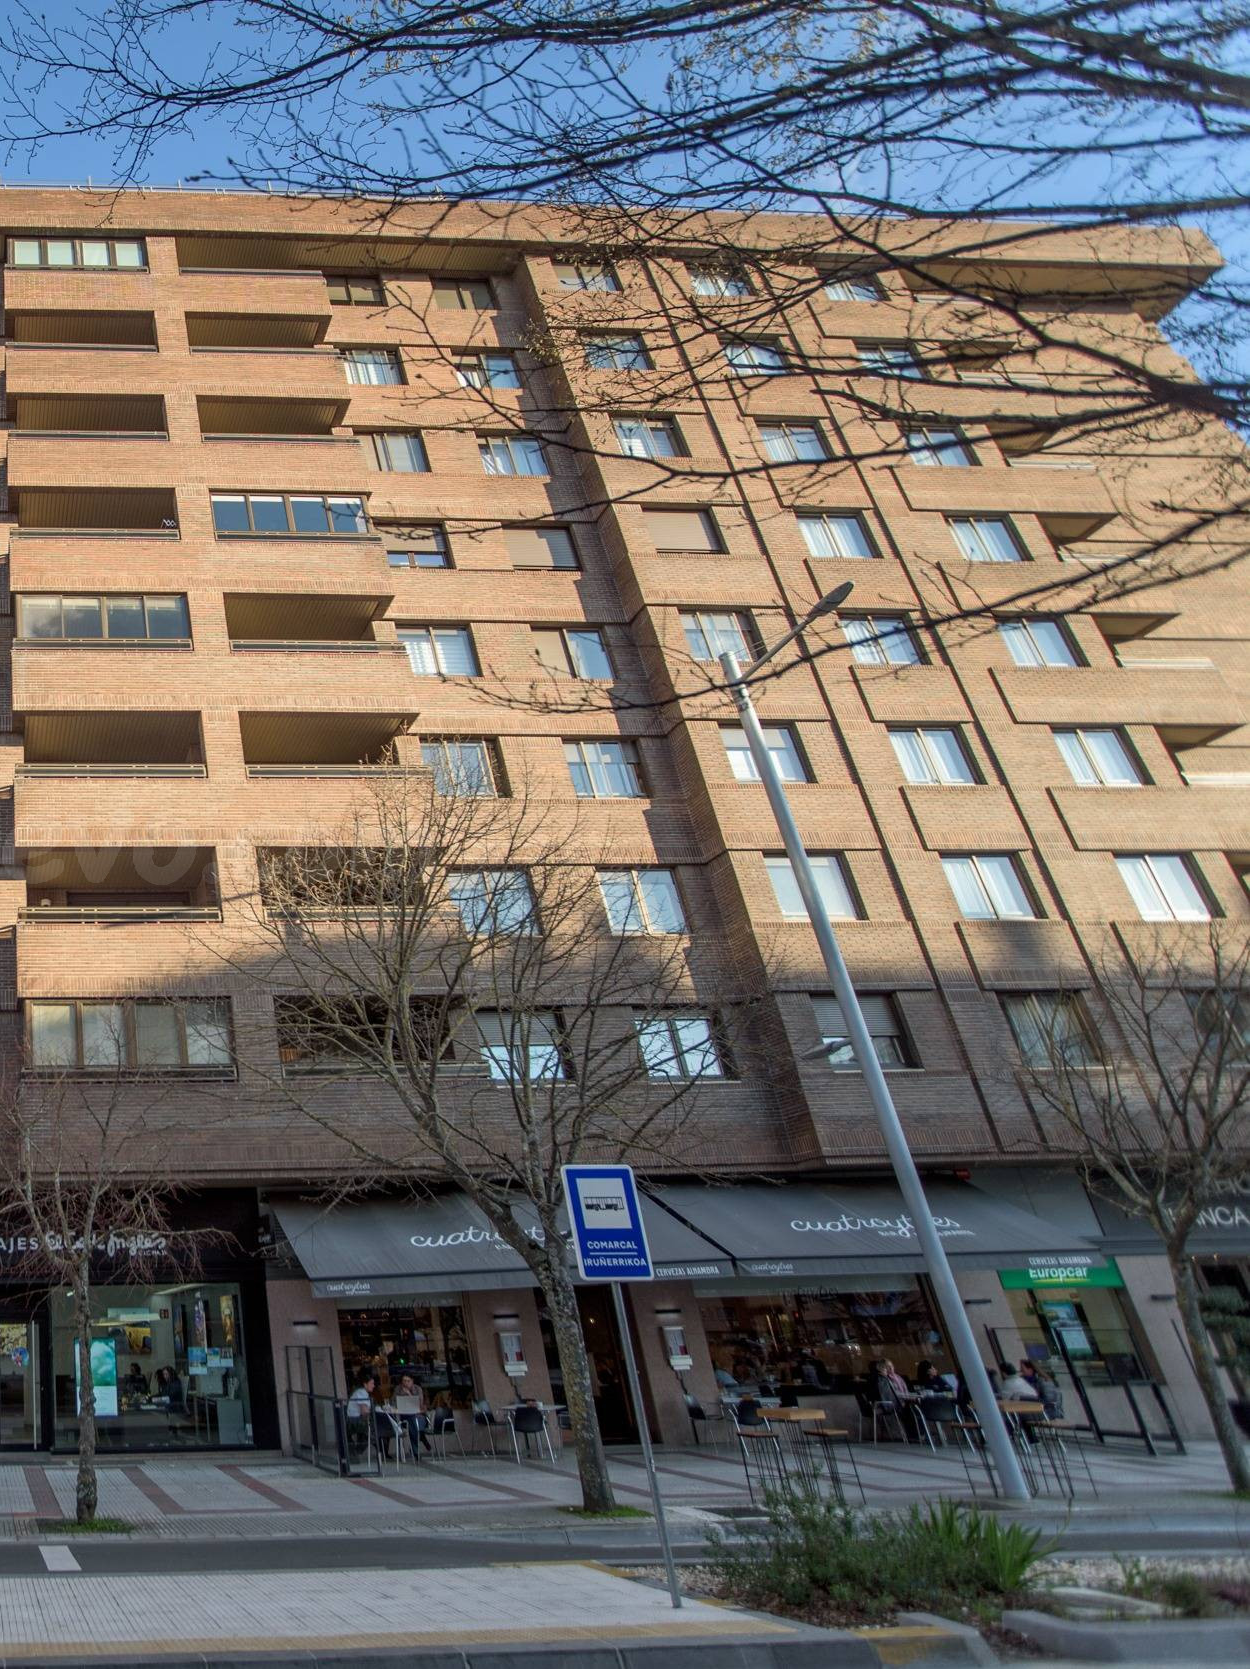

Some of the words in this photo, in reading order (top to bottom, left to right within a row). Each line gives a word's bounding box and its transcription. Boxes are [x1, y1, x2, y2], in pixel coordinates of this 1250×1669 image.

[790, 1214, 961, 1237] cuatroytes
[586, 1240, 638, 1250] COMARCAL
[583, 1256, 648, 1268] IRUÑERRIKOA
[656, 1267, 685, 1278] CERVEZAS
[686, 1265, 720, 1276] ALHAMBRA
[1028, 1267, 1088, 1283] Europcar
